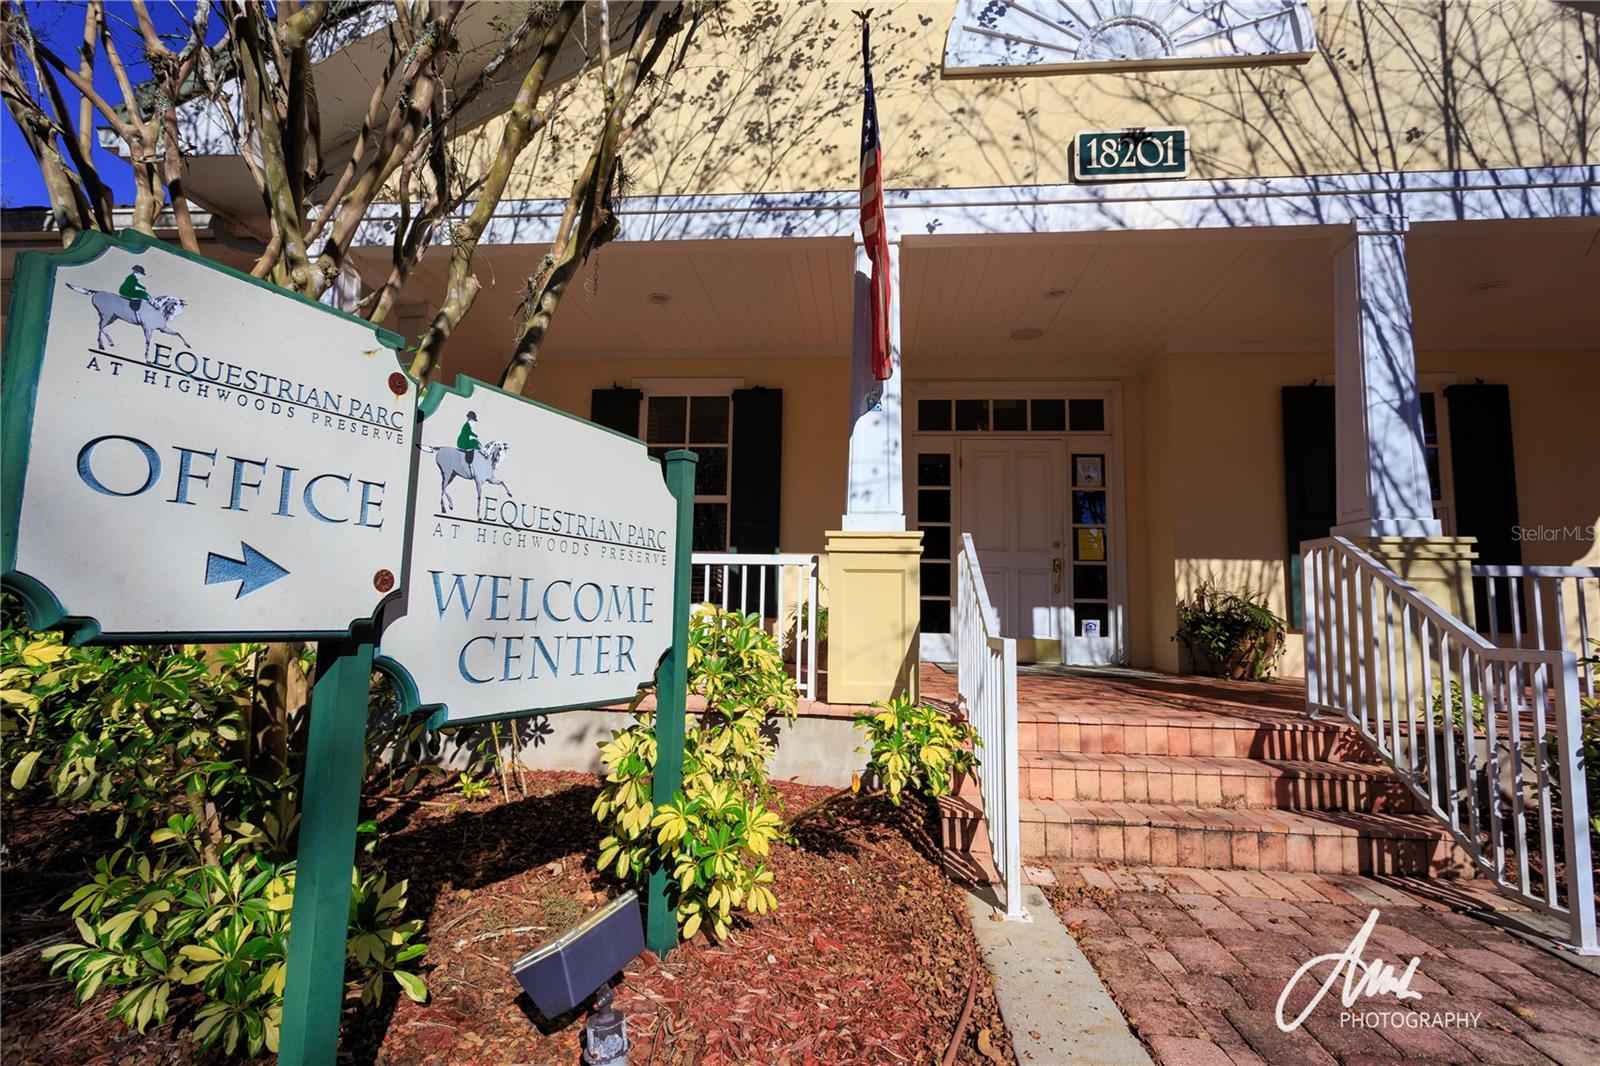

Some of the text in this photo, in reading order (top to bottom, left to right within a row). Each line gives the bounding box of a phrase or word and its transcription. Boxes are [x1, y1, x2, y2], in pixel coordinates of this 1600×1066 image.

[1086, 135, 1179, 169] 18201
[86, 357, 404, 445] AT HIGHWOODS PRESERVE
[151, 343, 404, 430] EQUESTRIAN PARC
[76, 435, 387, 532] OFFICE
[433, 522, 667, 567] AT HIGHWOODS PRESERVE
[483, 496, 667, 550] EQUESTRIAN PARC
[427, 569, 655, 626] WELCOME
[458, 632, 637, 684] CENTER
